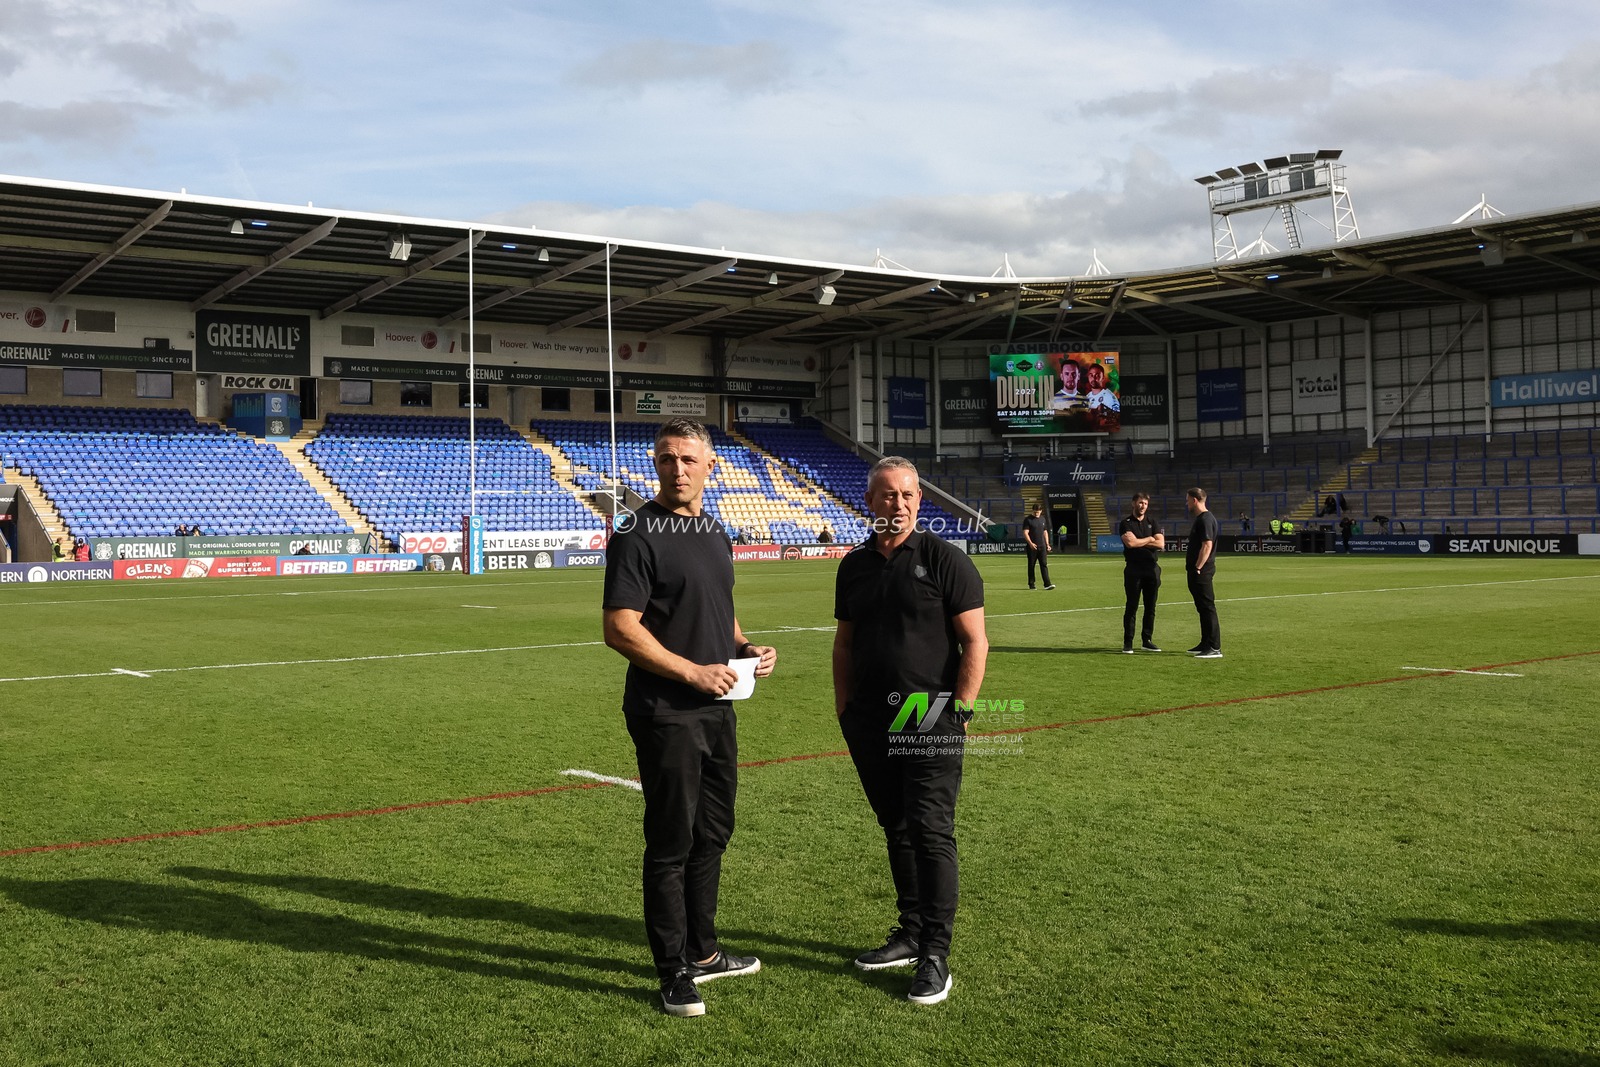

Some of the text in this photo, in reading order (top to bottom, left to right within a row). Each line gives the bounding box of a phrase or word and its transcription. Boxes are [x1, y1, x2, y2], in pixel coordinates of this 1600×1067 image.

[532, 341, 552, 350] Wash
[554, 342, 566, 351] the
[568, 345, 583, 353] way
[586, 345, 599, 353] you
[1007, 342, 1095, 354] ASHBROOK
[61, 352, 84, 360] MADE
[97, 354, 150, 362] WARRINGTON
[732, 353, 749, 362] Clean
[750, 355, 760, 363] the
[224, 376, 292, 389] ROCK OIL
[1296, 373, 1337, 394] Total
[1501, 374, 1600, 400] Halliwel
[996, 375, 1055, 409] DUBLIN
[482, 538, 564, 548] ENT LEASE BUY
[1234, 543, 1296, 552] UK Lift Escalator
[1448, 539, 1560, 554] SEAT UNIQUE
[568, 555, 601, 565] BOOST
[737, 551, 758, 560] MINT
[759, 550, 780, 559] BALLS
[282, 560, 347, 574] BETFRED
[355, 559, 417, 572] BETFRED
[488, 555, 528, 570] BEER
[51, 569, 112, 581] NORTHERN
[126, 563, 172, 576] GLEN'S
